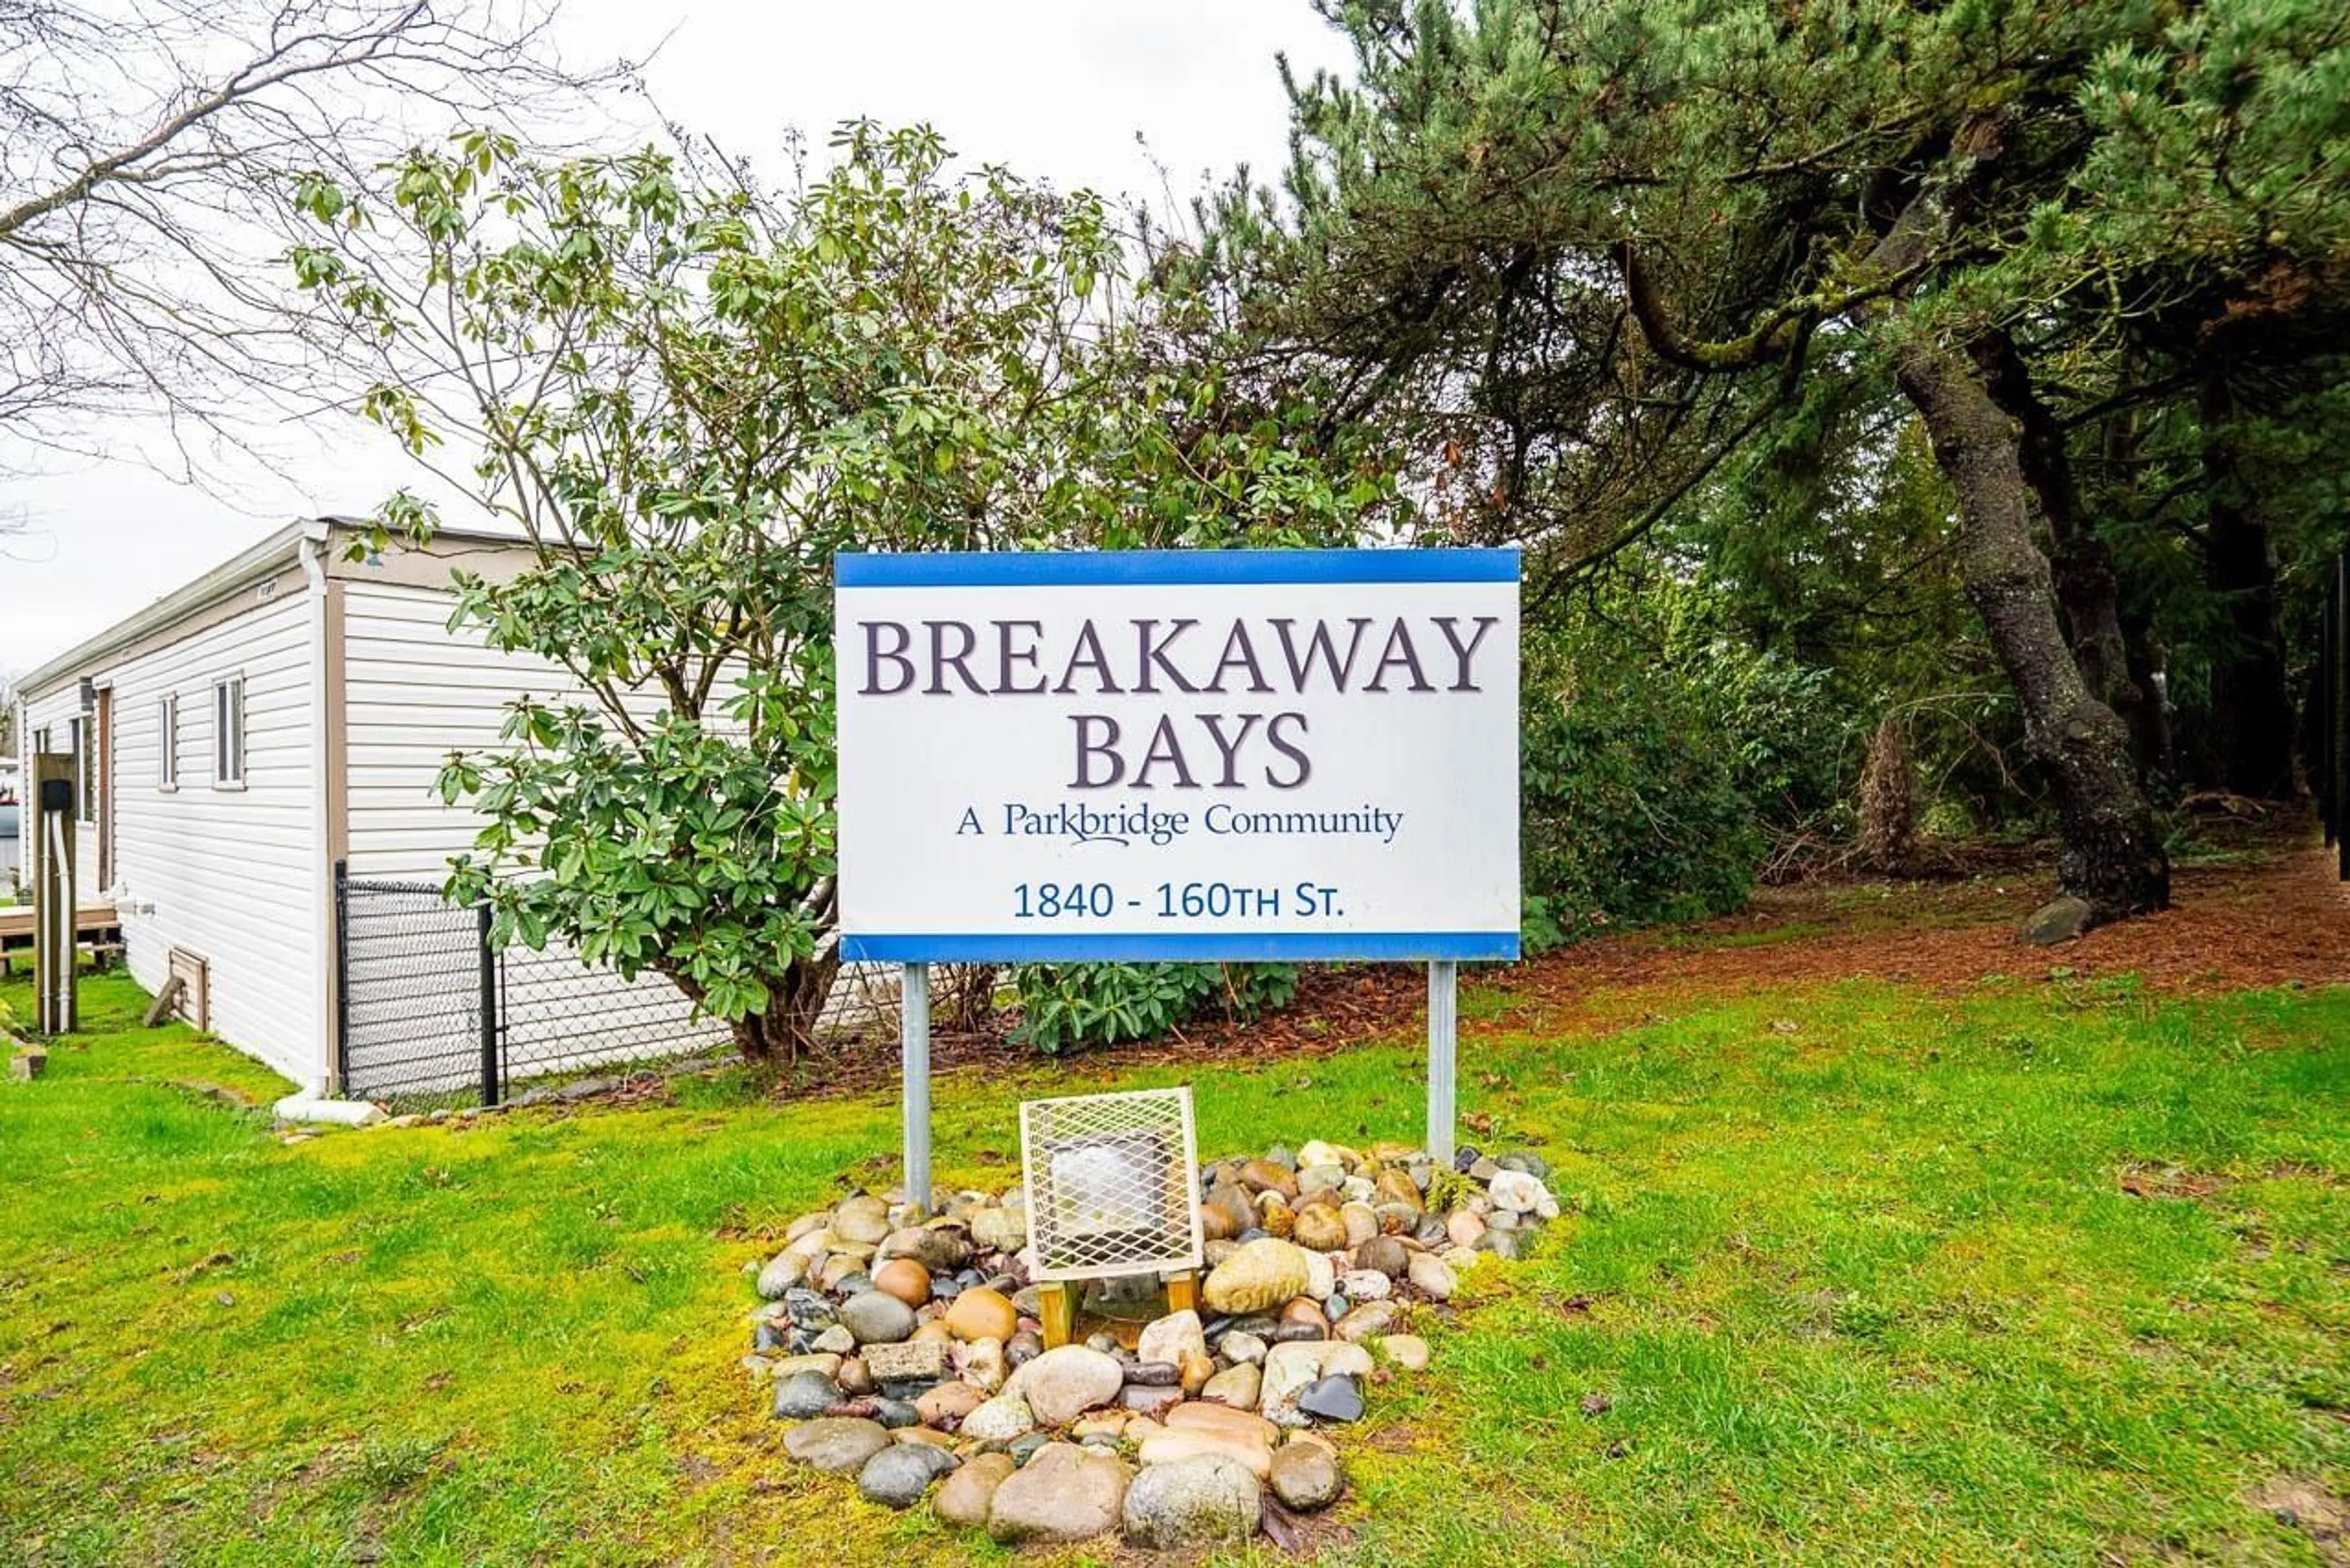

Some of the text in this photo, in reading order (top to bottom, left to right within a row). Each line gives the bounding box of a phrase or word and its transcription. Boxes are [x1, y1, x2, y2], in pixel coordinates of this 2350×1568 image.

[857, 616, 1499, 696] BREAKAWAY
[1067, 712, 1311, 790] BAYS
[957, 802, 1404, 847] A Parkbridge Community
[1014, 882, 1113, 917] 1840
[1157, 882, 1279, 917] 160TH
